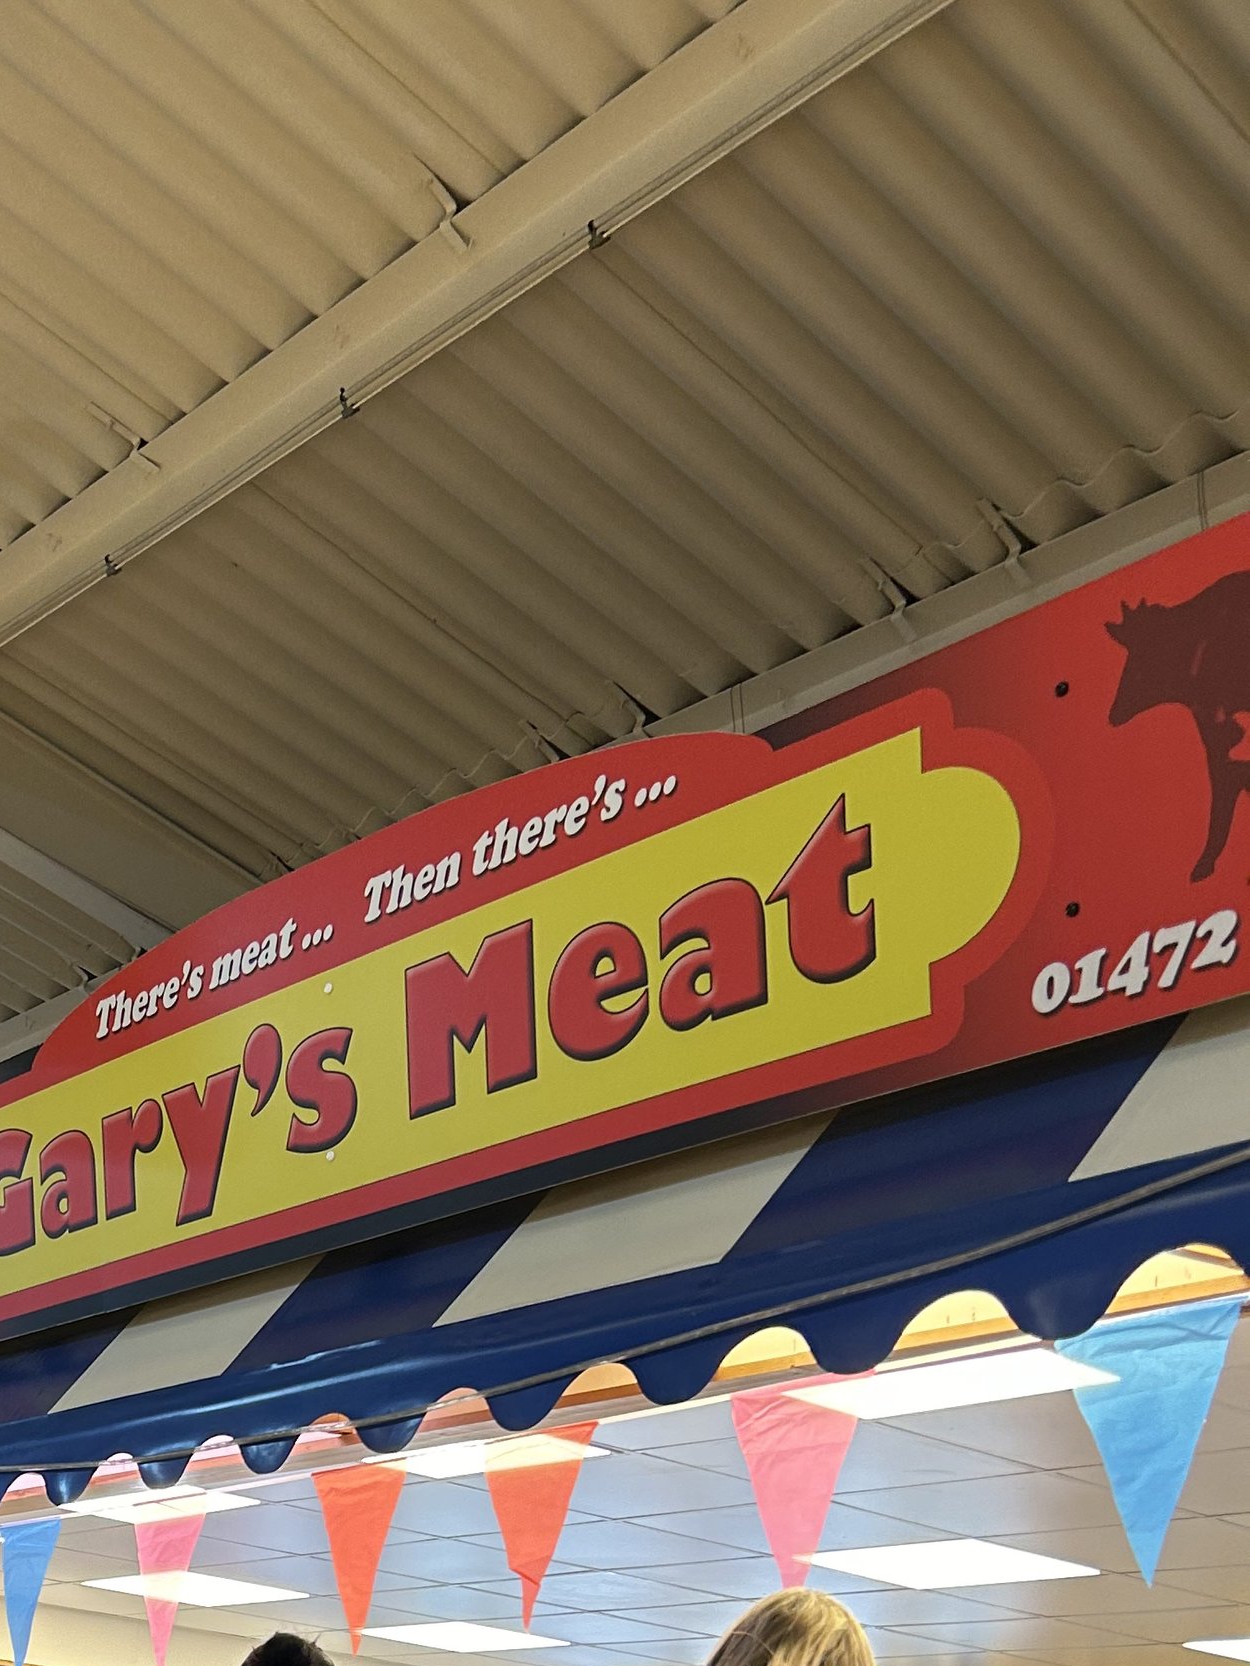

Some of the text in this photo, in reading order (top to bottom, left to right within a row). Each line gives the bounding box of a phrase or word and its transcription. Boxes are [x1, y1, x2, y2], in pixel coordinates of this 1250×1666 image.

[94, 960, 207, 1040] There's
[209, 918, 296, 989] meat
[363, 848, 461, 925] Then
[471, 774, 626, 877] there's
[404, 790, 878, 1121] Meat
[1029, 908, 1240, 1016] 01472
